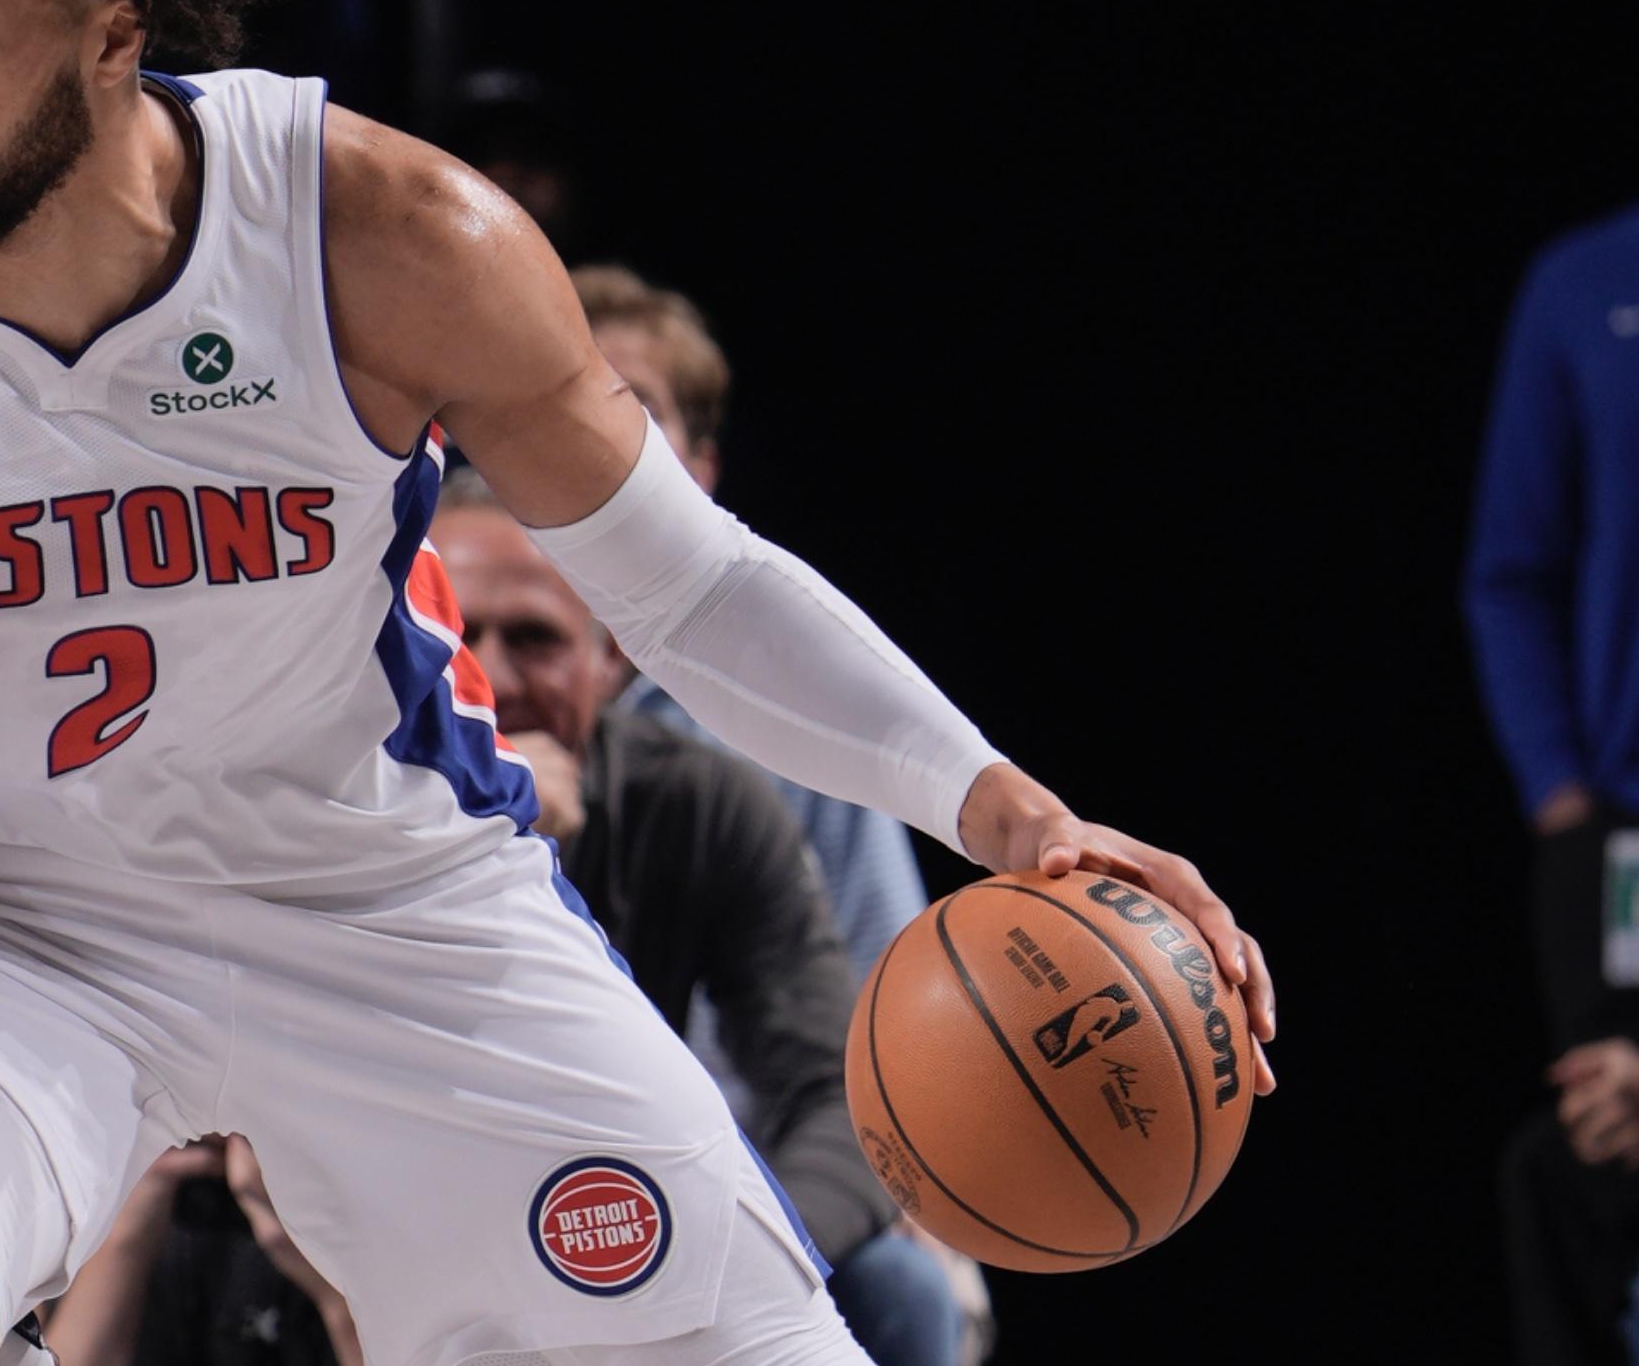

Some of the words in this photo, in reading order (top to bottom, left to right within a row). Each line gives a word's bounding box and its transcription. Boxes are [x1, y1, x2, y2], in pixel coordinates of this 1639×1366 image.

[150, 377, 276, 415] StockX
[45, 624, 157, 779] 2
[1085, 878, 1240, 1110] Wilson
[555, 1199, 638, 1232] DETROIT
[559, 1221, 645, 1254] PISTONS
